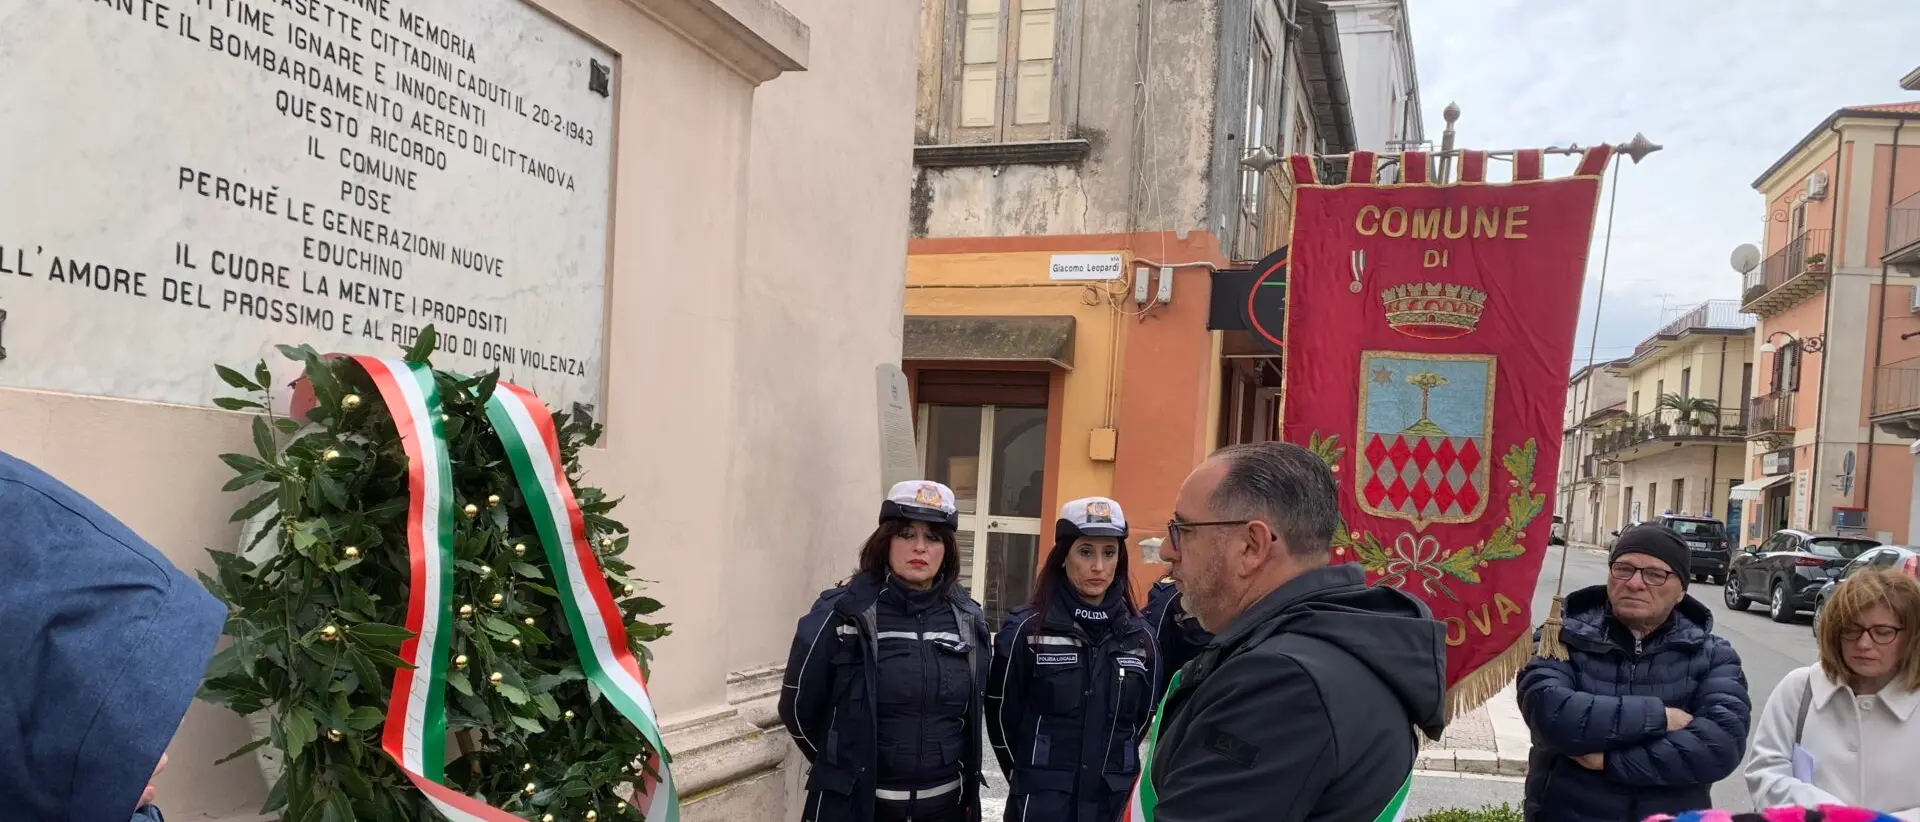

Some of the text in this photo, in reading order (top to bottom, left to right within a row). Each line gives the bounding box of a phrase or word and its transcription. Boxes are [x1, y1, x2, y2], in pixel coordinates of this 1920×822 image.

[400, 8, 475, 64] MEMORIA
[289, 23, 364, 75] IGNARE
[375, 62, 385, 85] E
[396, 72, 485, 127] INNOCENTI
[371, 28, 452, 82] CITTADINI
[458, 69, 510, 109] CADUTI
[516, 96, 527, 117] IL
[180, 13, 200, 42] IL
[210, 25, 402, 122] BOMBARDAMENTO
[411, 111, 467, 149] AEREO
[474, 135, 487, 157] DI
[492, 143, 574, 191] CITTANOVA
[276, 90, 446, 170] QUESTO RICORDO
[309, 136, 417, 190] IL COMUNE
[341, 180, 391, 214] POSE
[1355, 204, 1530, 240] COMUNE
[287, 198, 315, 225] LE
[323, 209, 444, 260] GENERAZIONI
[452, 247, 503, 277] NUOVE
[304, 237, 402, 280] EDUCHINO
[1423, 249, 1449, 268] DI
[176, 242, 506, 334] IL CUORE LA MENTE I PROPOSITI
[1053, 263, 1119, 273] Giacomo Leopardi
[162, 278, 211, 309] DEL
[223, 289, 333, 331] PROSSIMO
[343, 314, 352, 335] E
[362, 319, 383, 341] AL
[392, 323, 457, 353] RIPDIO
[463, 338, 476, 357] DI
[483, 342, 515, 364] OGNI
[520, 348, 584, 377] VIOLENZA
[1075, 608, 1109, 620] POLIZIA
